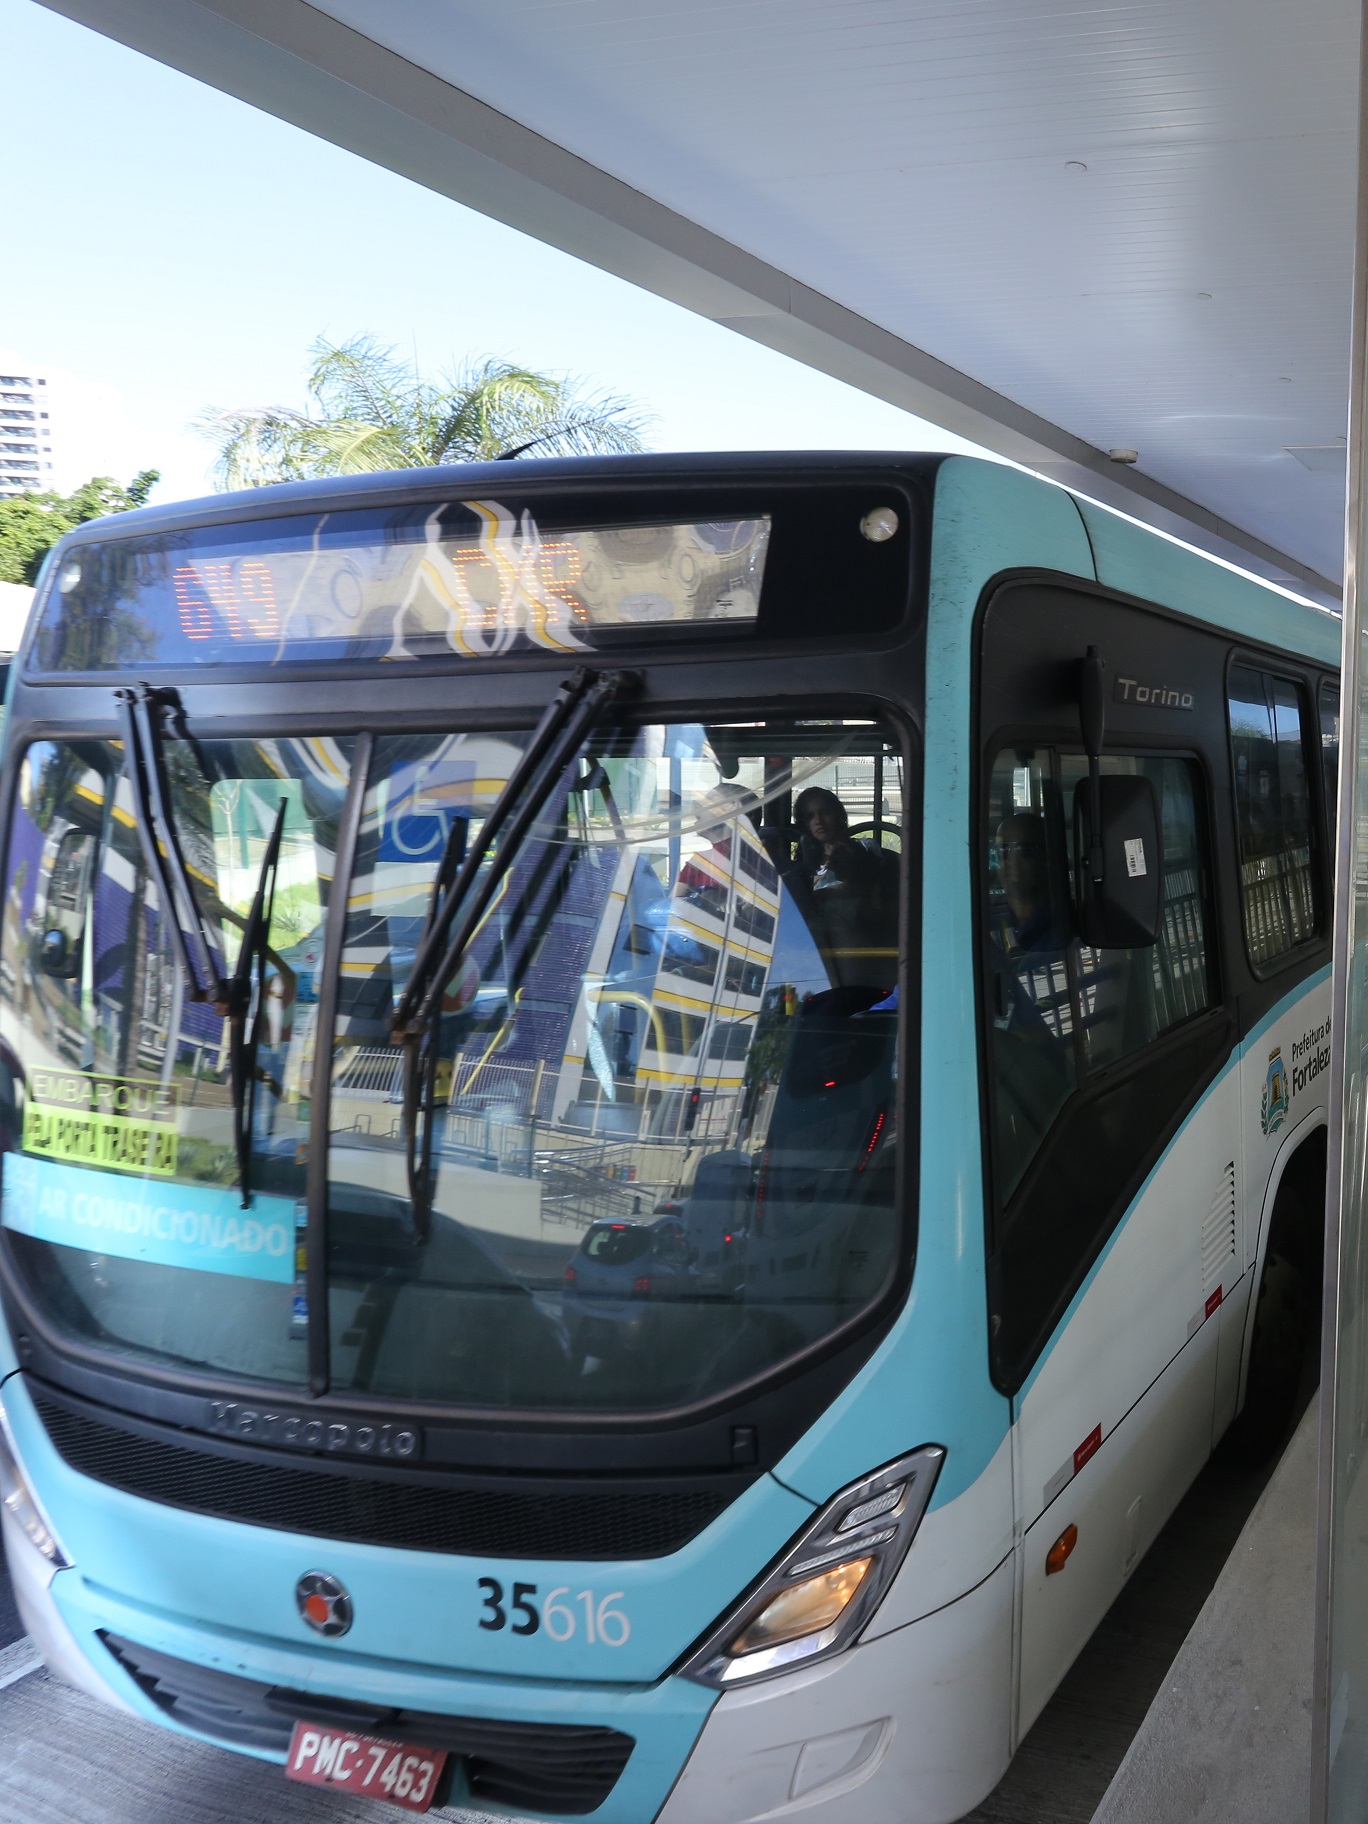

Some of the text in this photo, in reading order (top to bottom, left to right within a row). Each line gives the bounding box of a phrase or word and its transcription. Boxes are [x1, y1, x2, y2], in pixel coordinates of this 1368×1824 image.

[1118, 678, 1194, 707] Torino
[1292, 1024, 1325, 1062] Prefeitura
[31, 1073, 171, 1115] EMBARQUE
[38, 1185, 288, 1257] AR CONDICIONADO
[208, 1401, 415, 1457] Marcopolo
[477, 1576, 631, 1647] 35616
